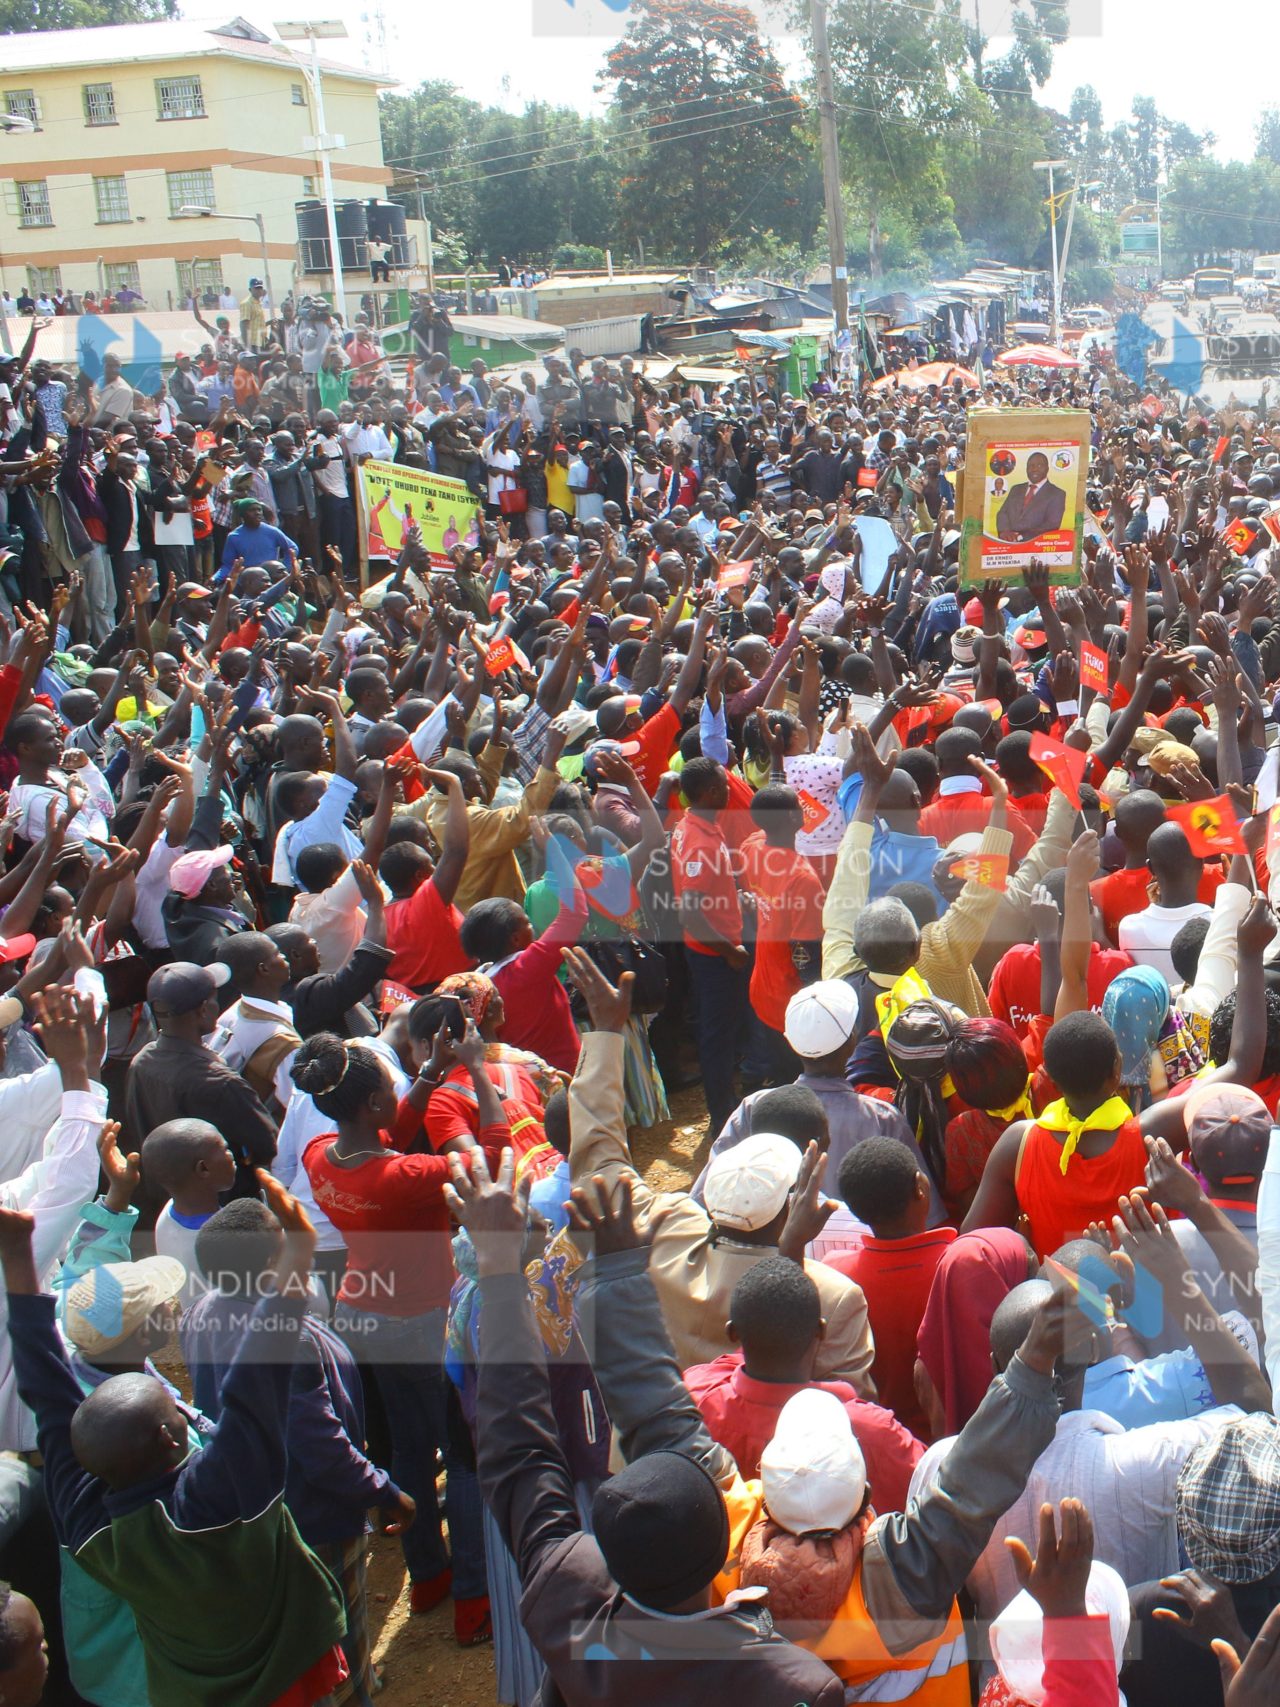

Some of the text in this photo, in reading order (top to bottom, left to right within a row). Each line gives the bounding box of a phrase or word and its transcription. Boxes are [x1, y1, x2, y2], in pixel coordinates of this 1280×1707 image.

[420, 487, 437, 498] TENA
[1083, 652, 1105, 672] TUKO
[1083, 665, 1105, 681] PAMOJA
[385, 987, 414, 1003] TUK
